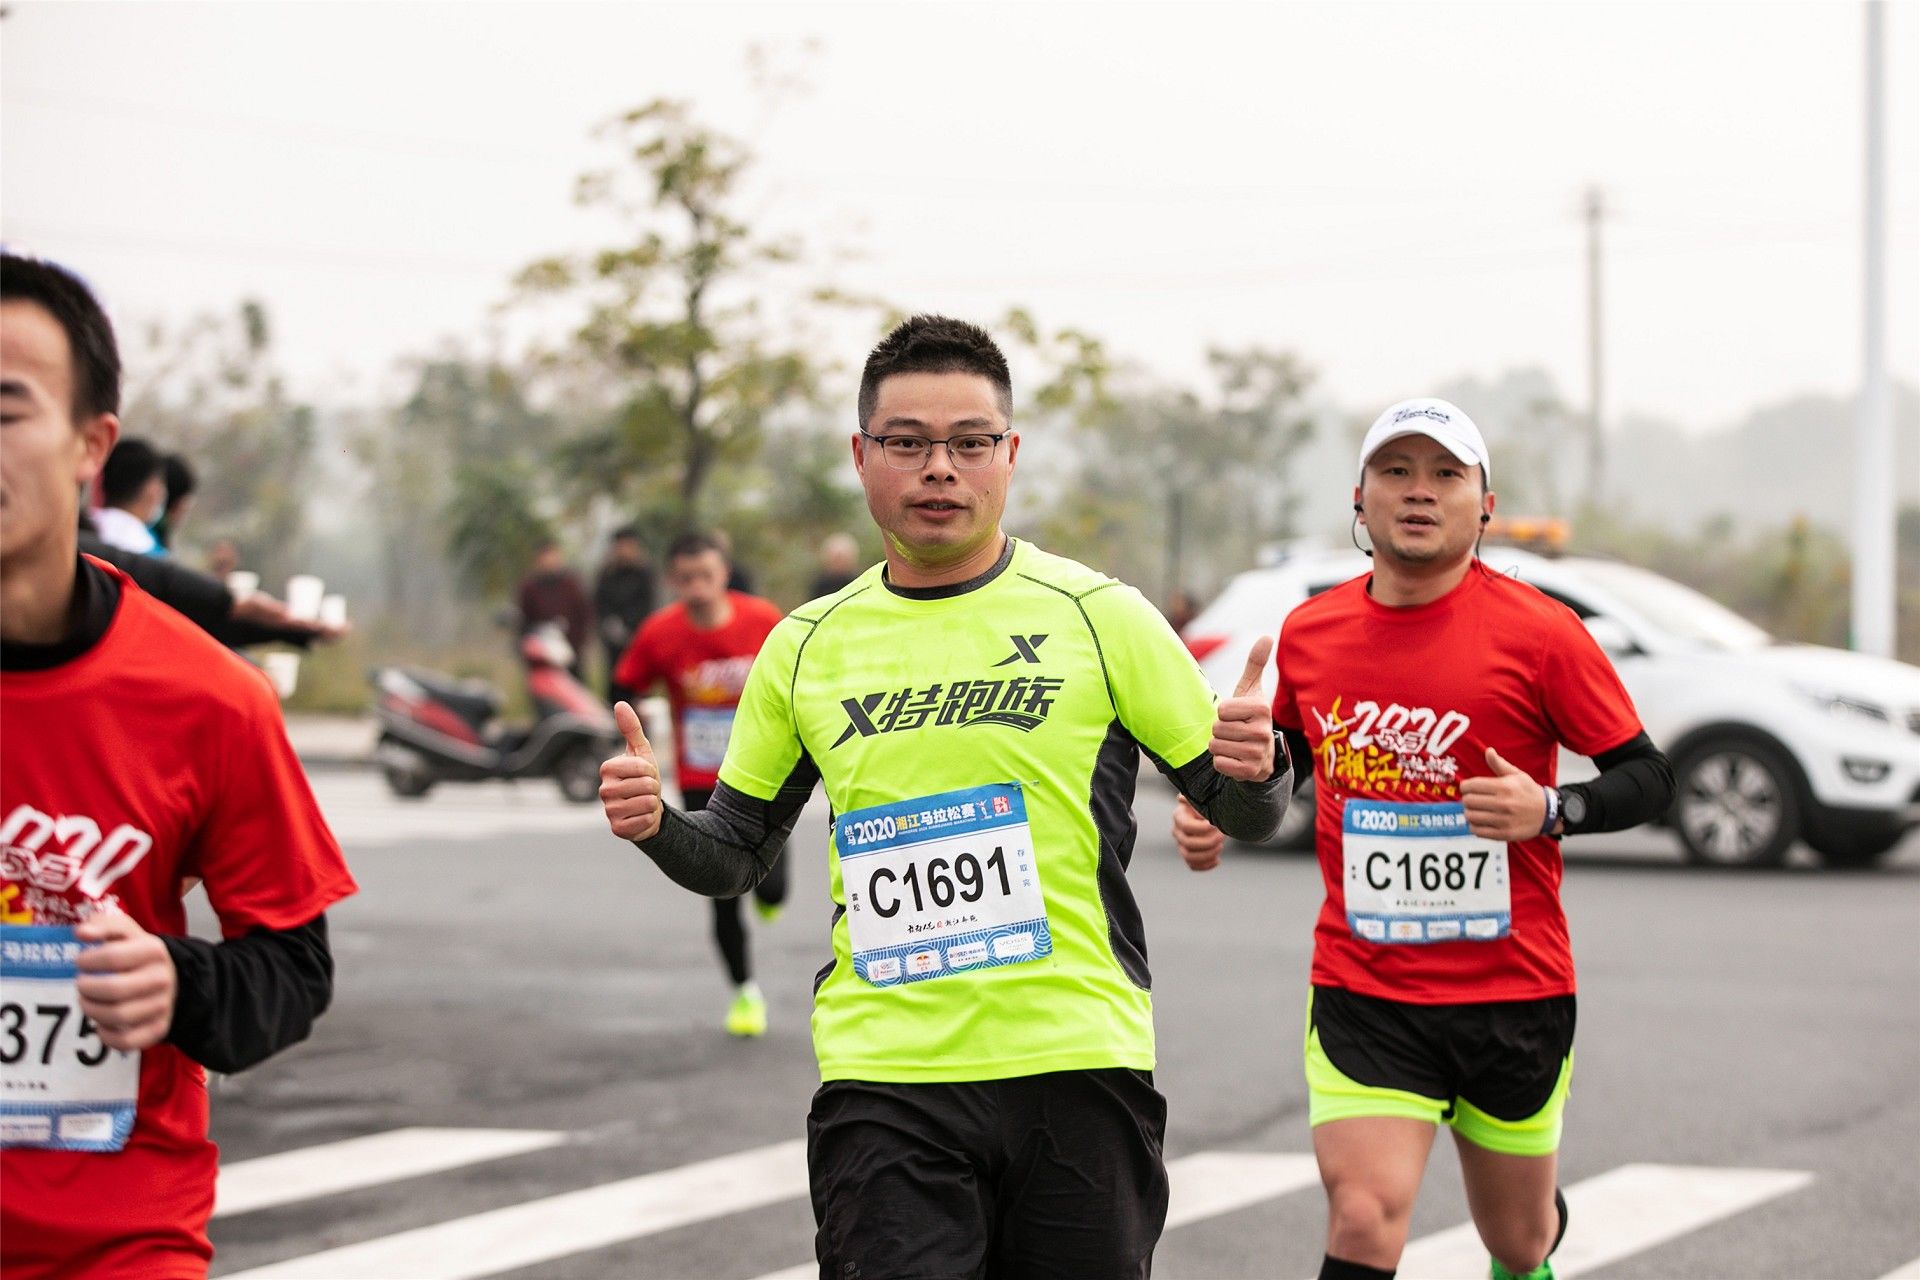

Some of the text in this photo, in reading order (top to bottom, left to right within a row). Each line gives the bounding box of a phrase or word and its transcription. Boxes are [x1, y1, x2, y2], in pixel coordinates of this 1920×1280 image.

[1349, 700, 1470, 757] 2020
[1336, 743, 1402, 783] 湘江
[868, 846, 1011, 918] C1691
[1366, 851, 1489, 891] C1687
